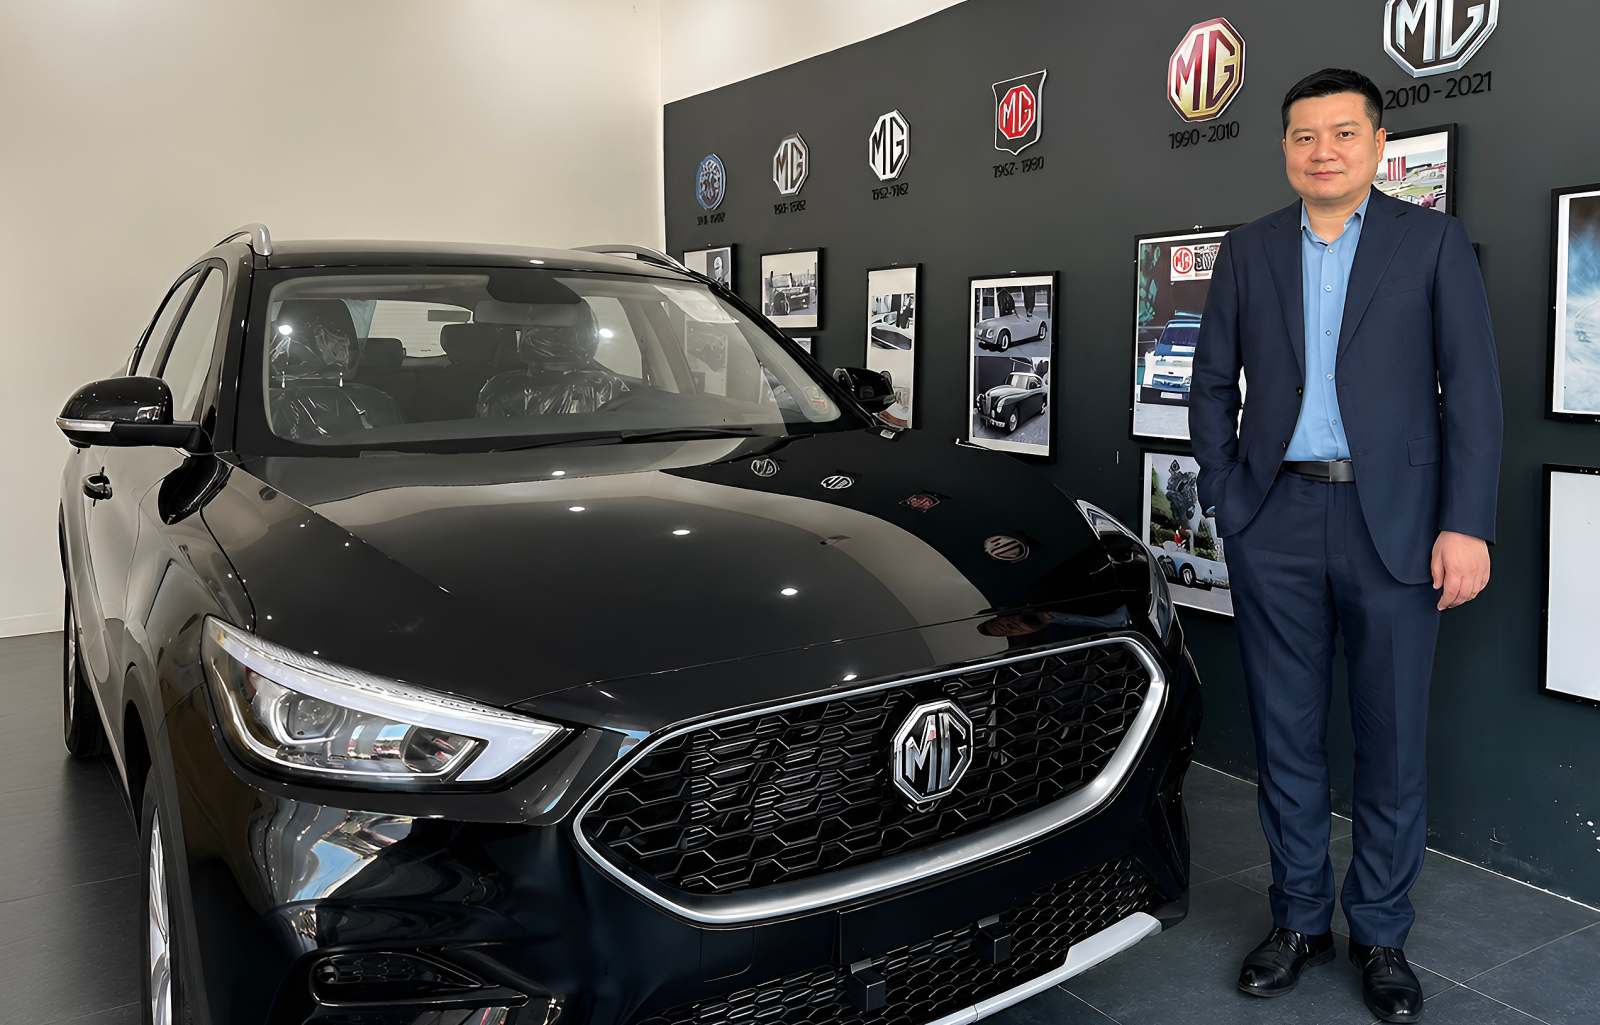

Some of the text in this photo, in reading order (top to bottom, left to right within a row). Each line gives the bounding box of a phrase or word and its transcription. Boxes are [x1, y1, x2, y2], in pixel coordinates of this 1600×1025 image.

[1392, 0, 1485, 63] MG
[1175, 29, 1236, 111] MG
[1384, 71, 1493, 110] 2010-2021
[1003, 90, 1032, 134] MG
[1168, 120, 1241, 150] 1990-2010
[871, 115, 905, 176] MG
[904, 711, 968, 794] MG
